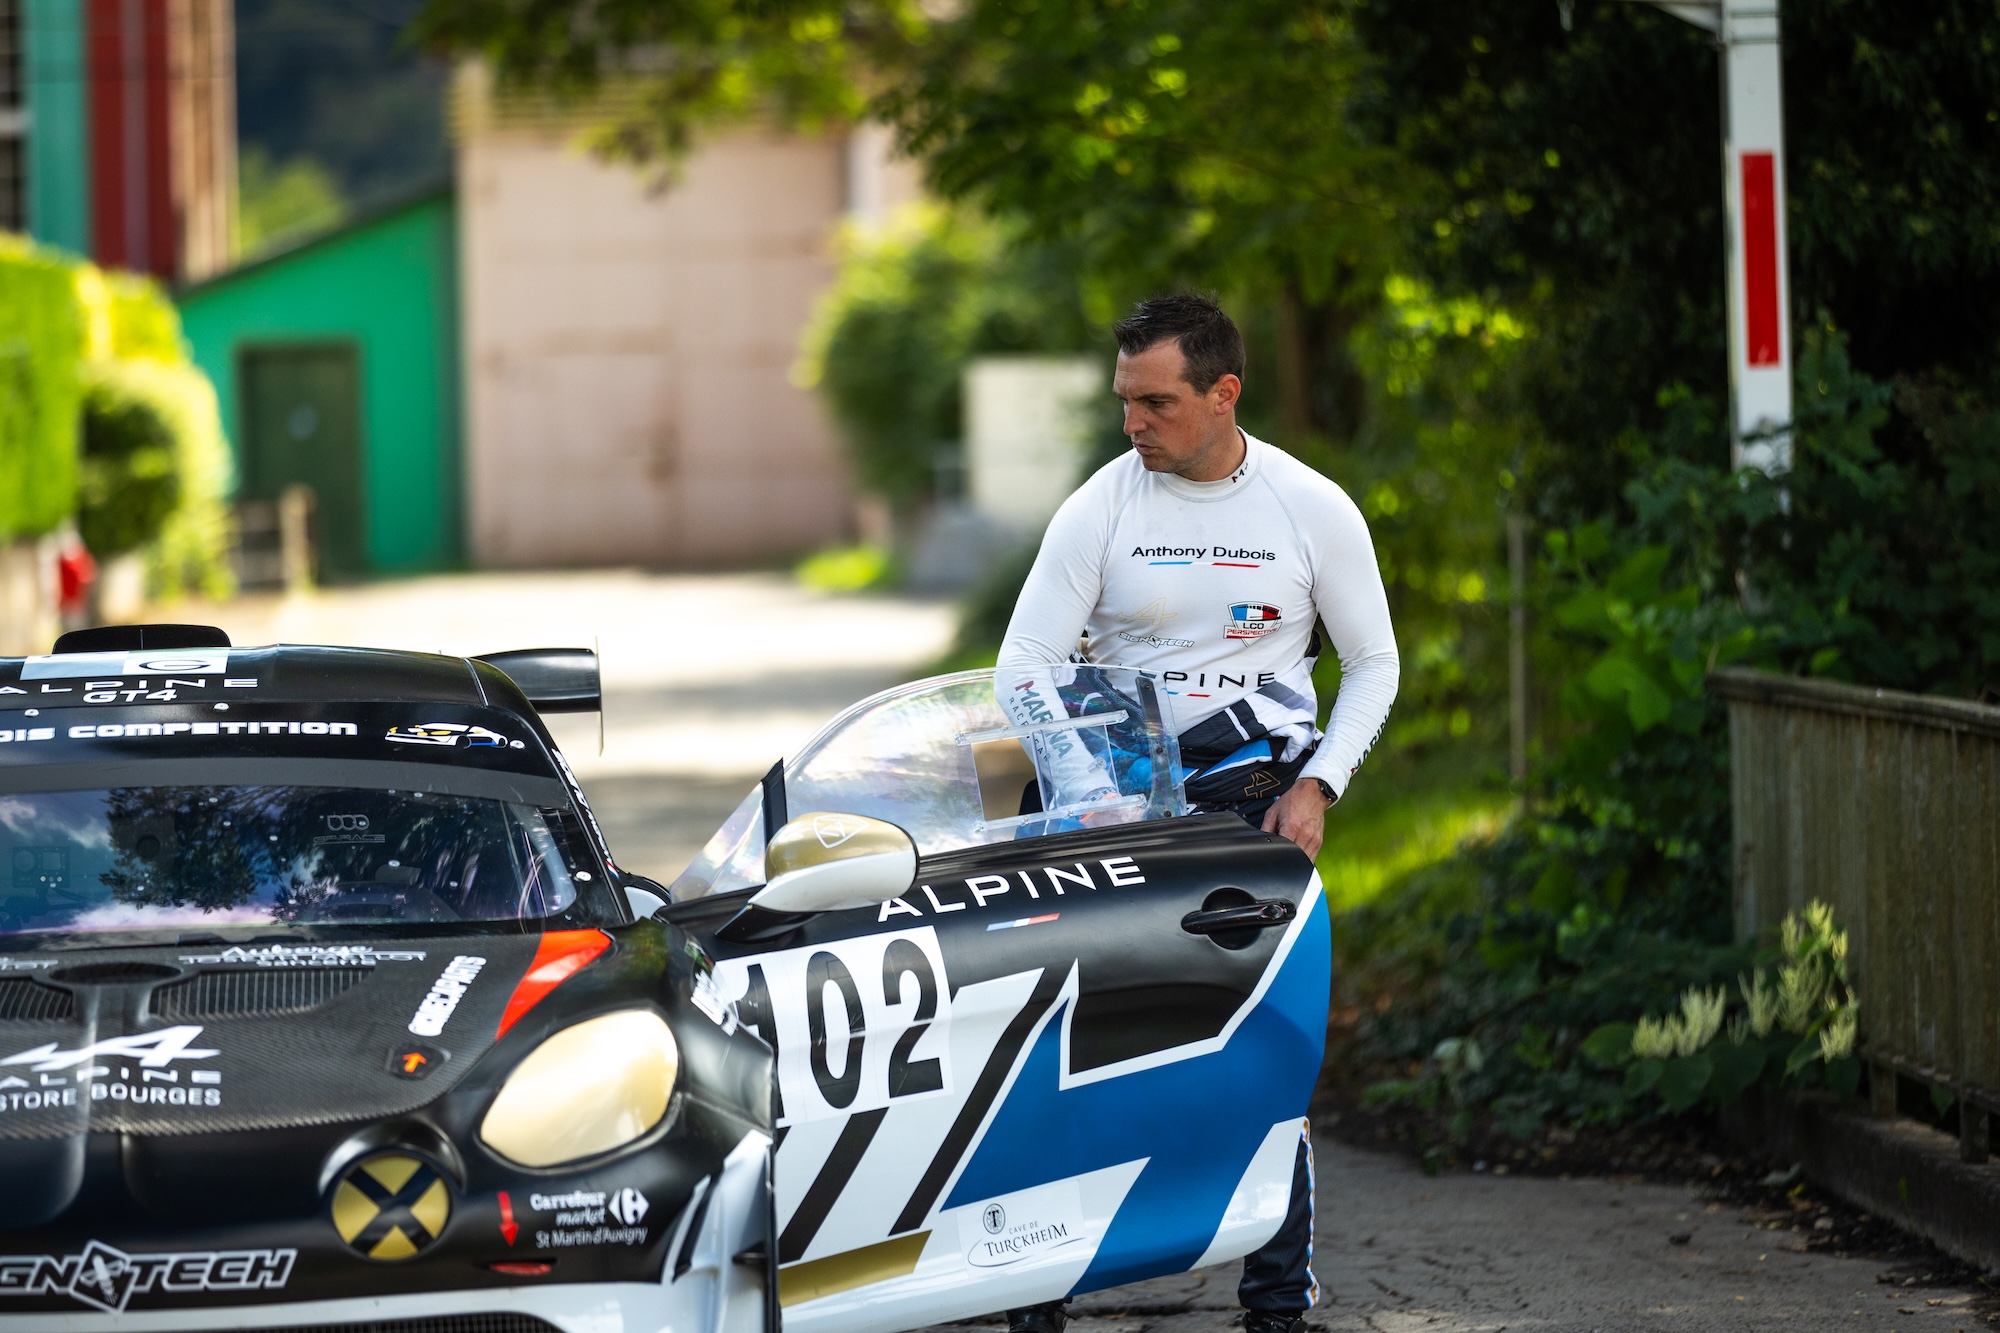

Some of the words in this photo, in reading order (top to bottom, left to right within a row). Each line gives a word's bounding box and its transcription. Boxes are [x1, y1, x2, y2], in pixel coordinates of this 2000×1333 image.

[1131, 546, 1207, 559] Anthony
[1213, 546, 1276, 561] Dubois
[0, 678, 259, 695] ALPINE
[83, 690, 177, 704] GT4
[1014, 680, 1074, 758] MARNA
[68, 722, 358, 739] COMPETITION
[877, 856, 1146, 922] ALPINE
[735, 938, 944, 1119] 102
[91, 1082, 221, 1106] BOURGES
[530, 1190, 606, 1211] Carrefour
[556, 1207, 606, 1226] market
[1008, 1225, 1027, 1235] CAVE
[1029, 1220, 1039, 1229] DE
[535, 1230, 550, 1248] St
[551, 1228, 591, 1247] Martin
[984, 1222, 1068, 1257] TURCKHEIM
